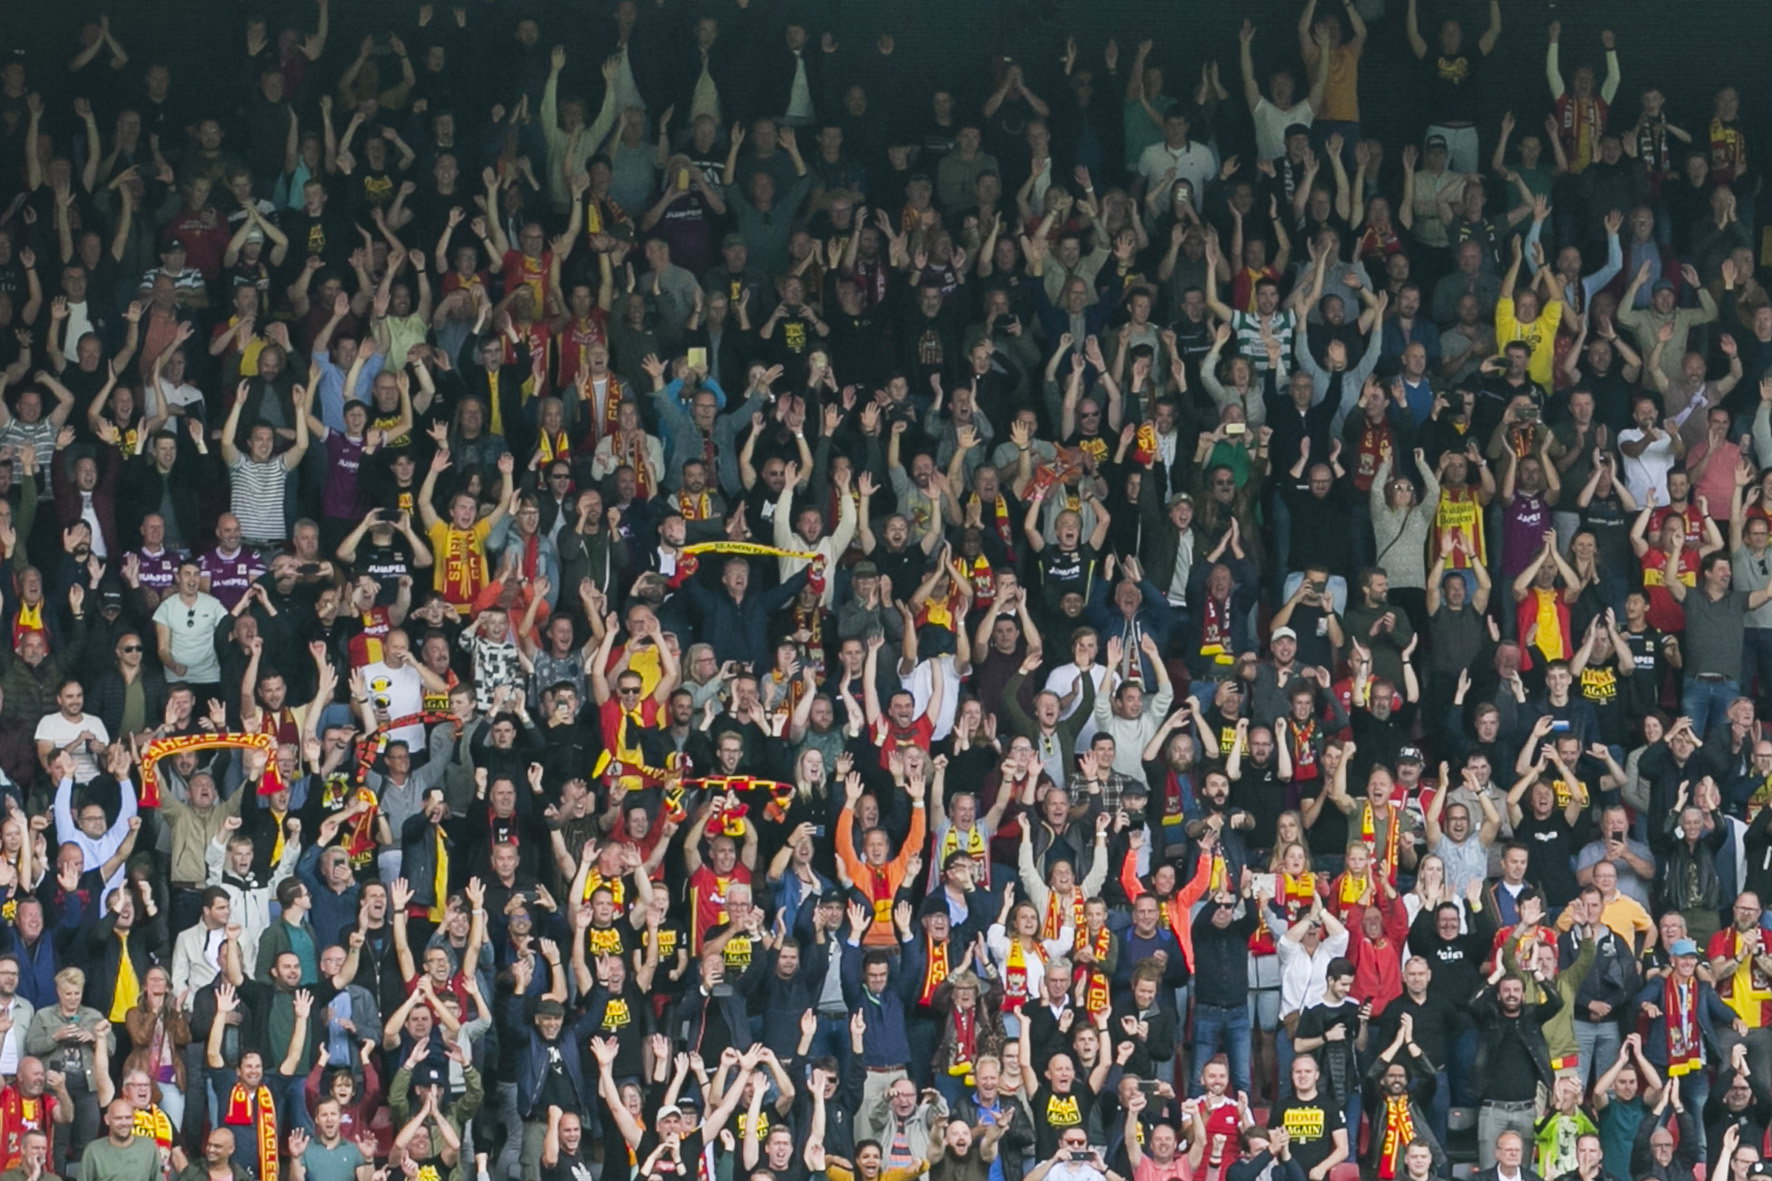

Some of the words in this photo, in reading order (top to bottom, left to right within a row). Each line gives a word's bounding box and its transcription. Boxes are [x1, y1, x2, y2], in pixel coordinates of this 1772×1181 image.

[425, 698, 450, 712] AGAI
[1284, 1109, 1325, 1125] HOME
[1286, 1124, 1322, 1137] AGAIN
